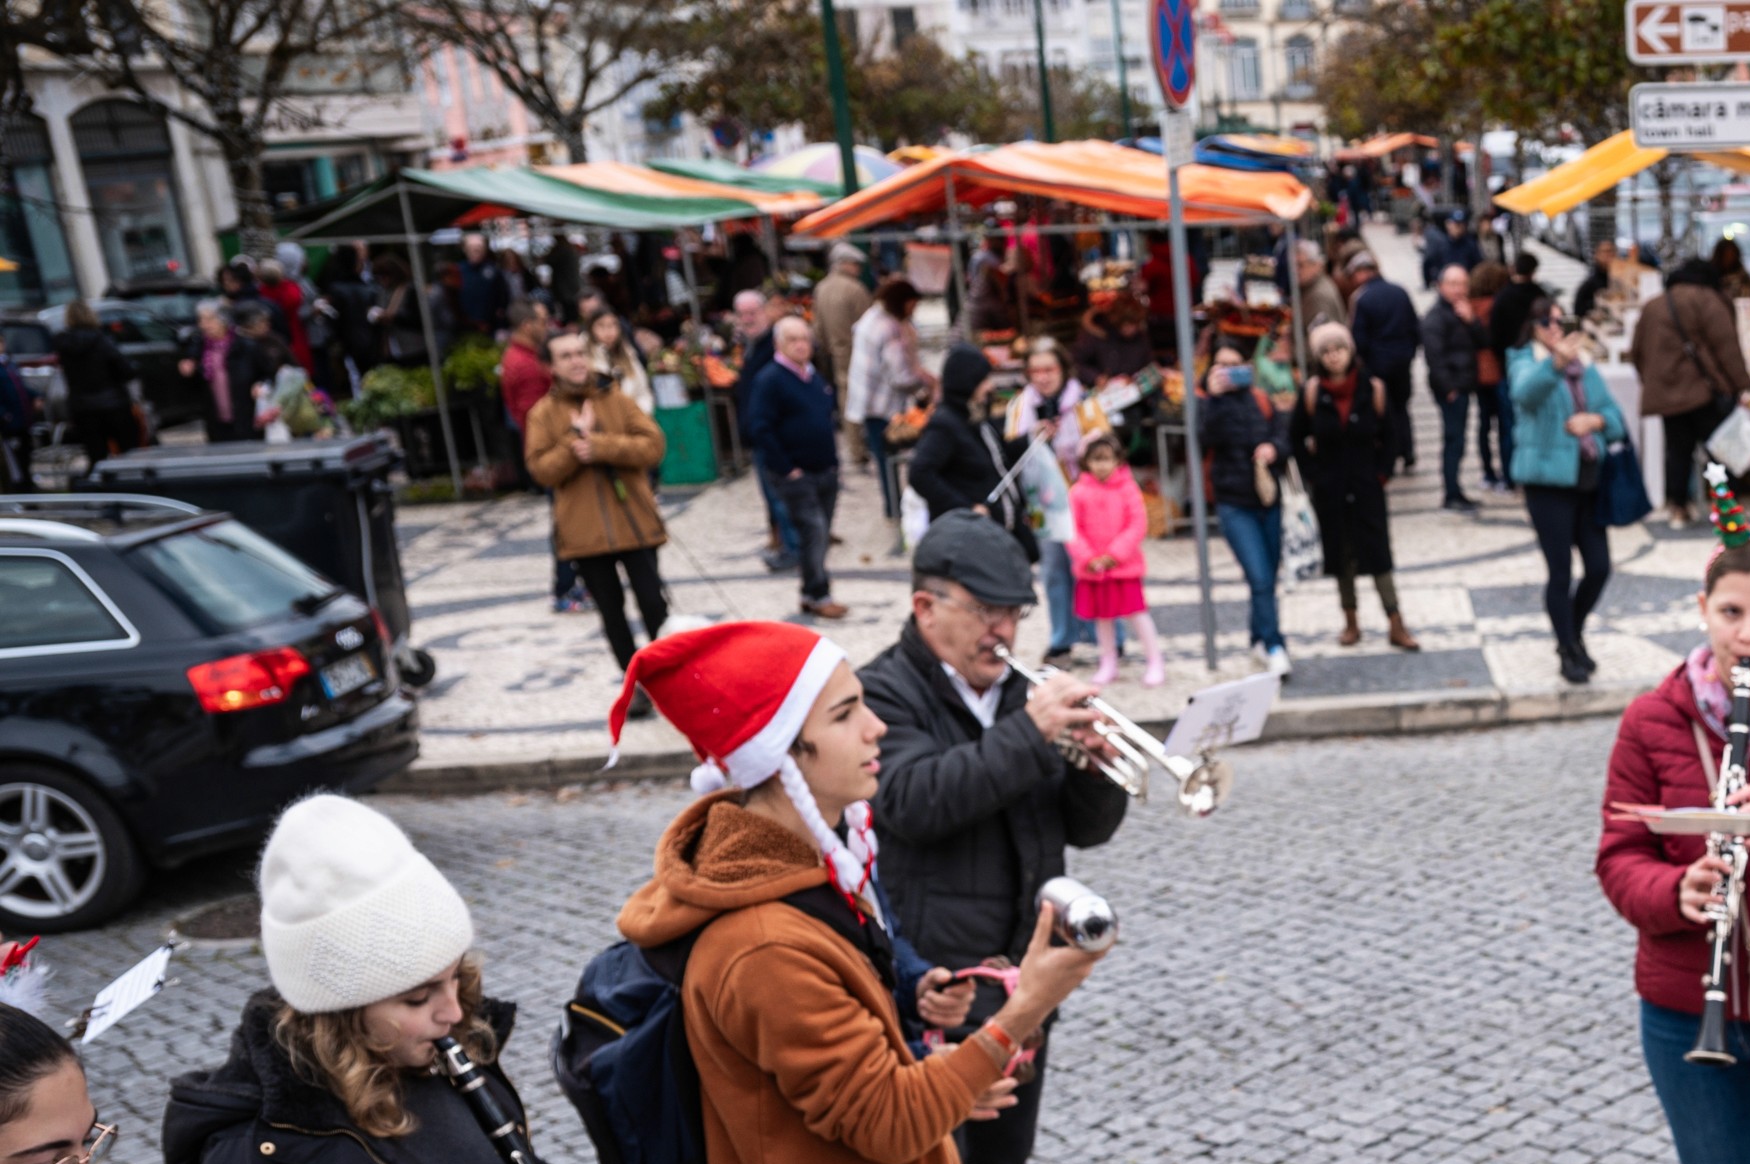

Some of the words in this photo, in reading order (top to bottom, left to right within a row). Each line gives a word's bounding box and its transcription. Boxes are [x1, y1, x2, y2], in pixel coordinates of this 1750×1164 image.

[1640, 97, 1727, 118] câmara
[1642, 126, 1679, 138] town
[1685, 125, 1715, 137] hall
